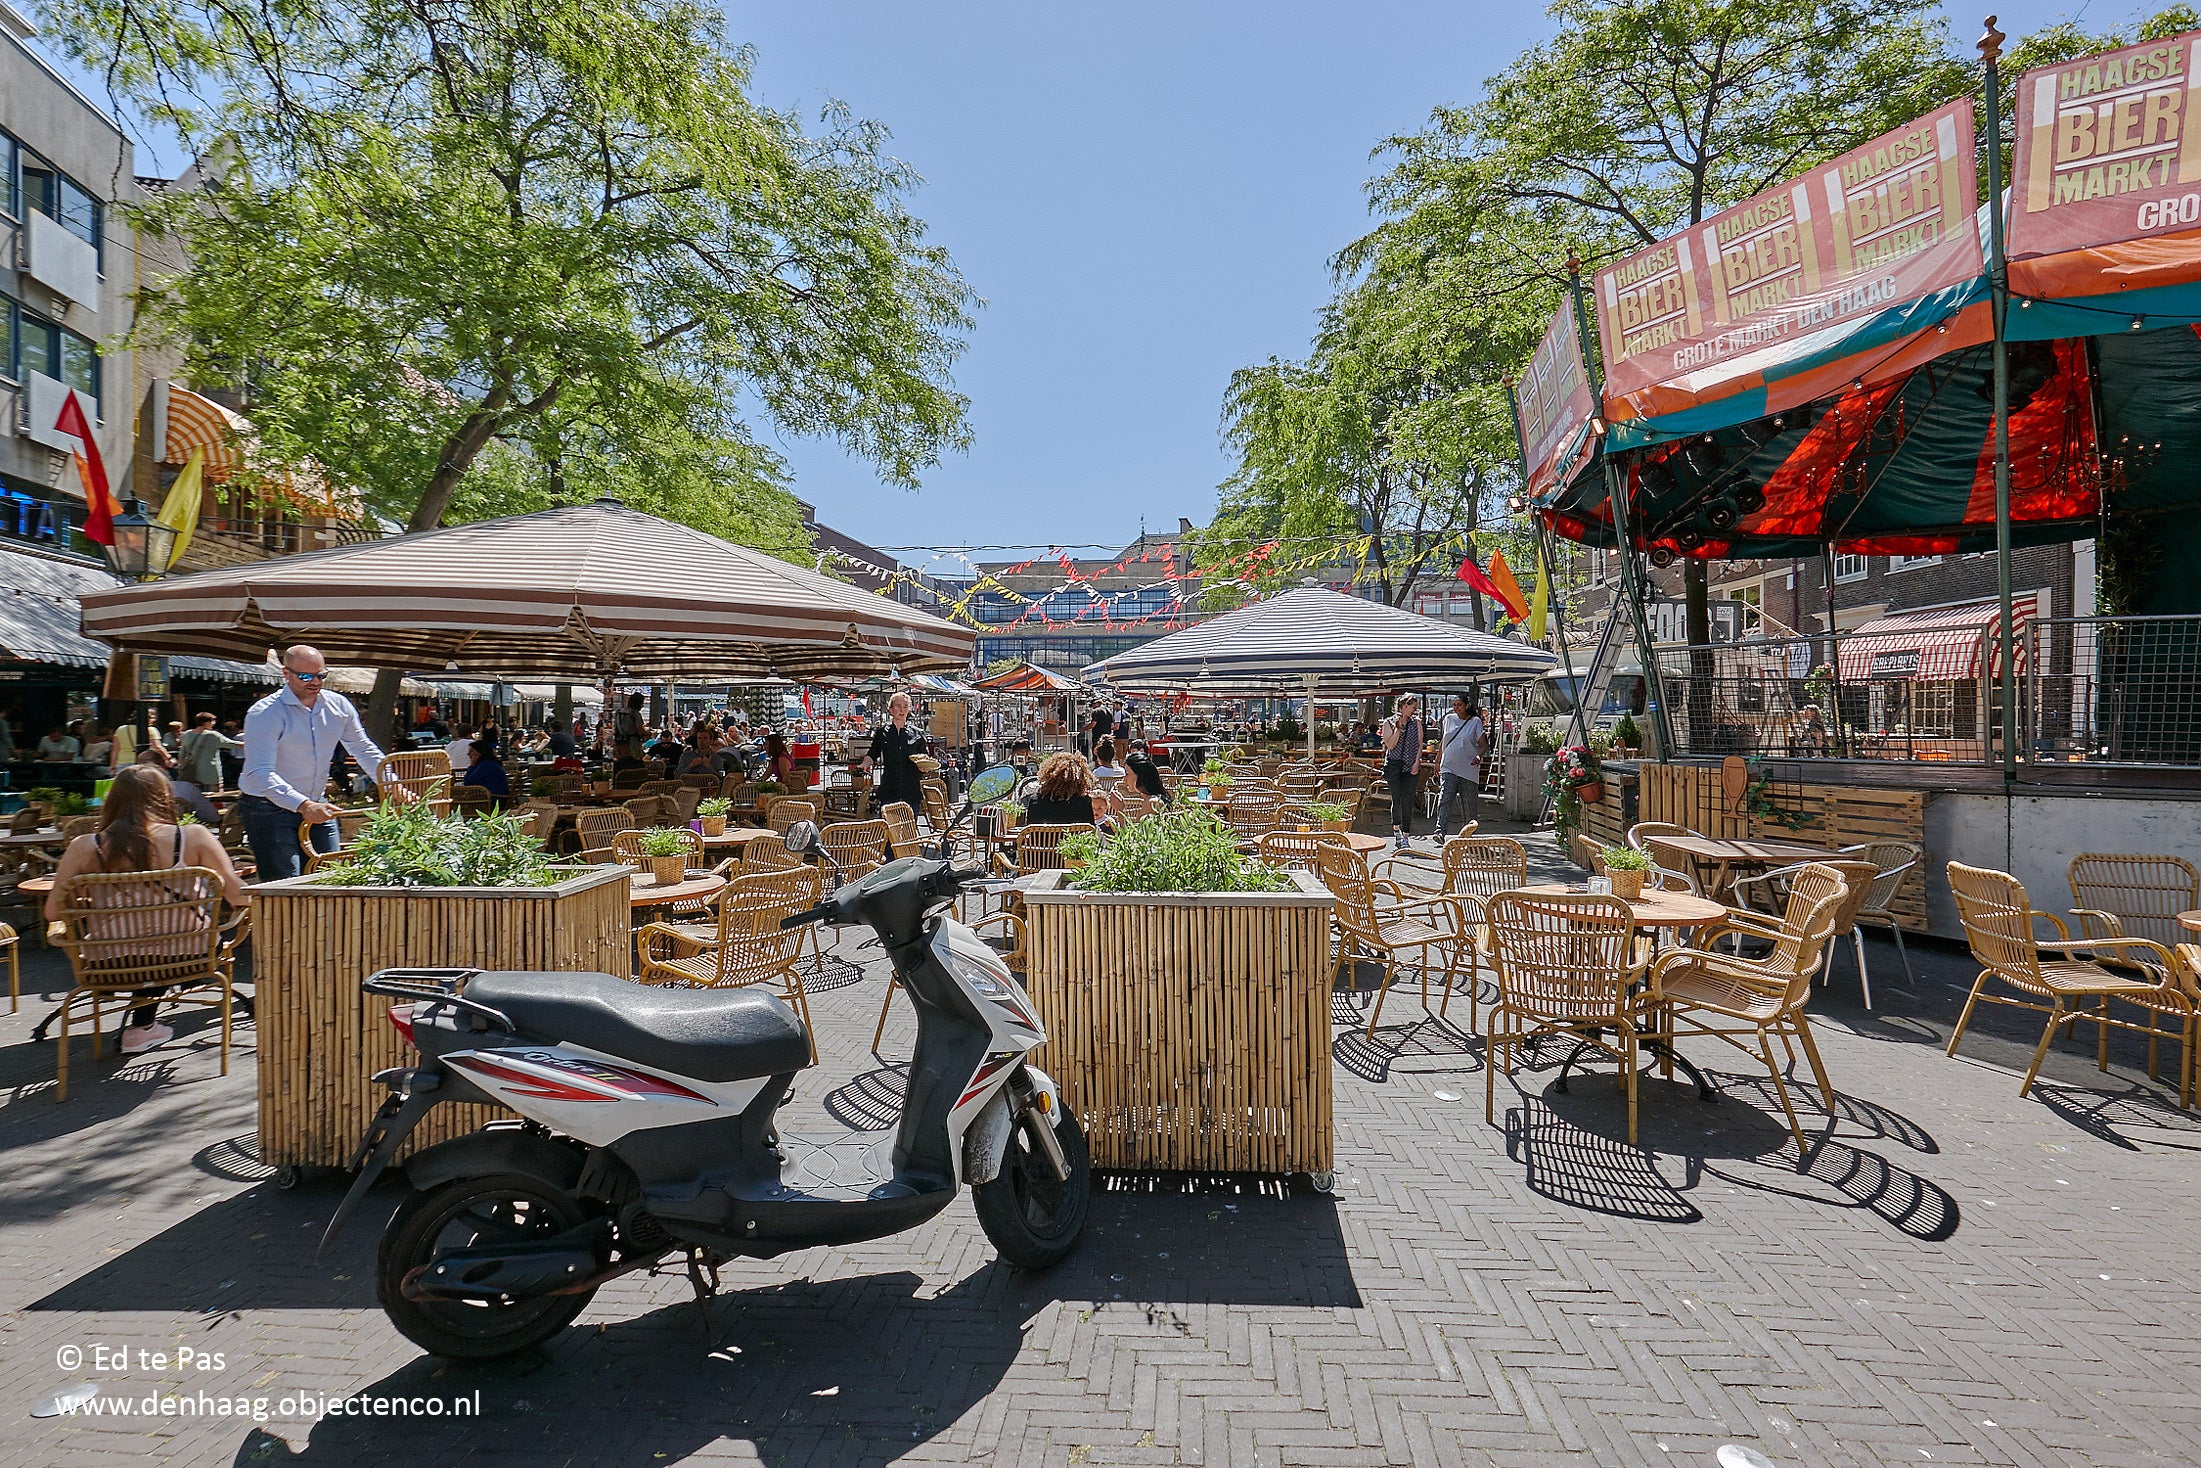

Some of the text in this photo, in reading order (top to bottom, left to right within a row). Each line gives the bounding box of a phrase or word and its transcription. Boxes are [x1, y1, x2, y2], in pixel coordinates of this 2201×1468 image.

[2060, 45, 2184, 101] HAAGSE
[2056, 88, 2183, 164] BIER
[1842, 126, 1934, 188] HAAGSE
[2053, 152, 2178, 207] MARKT
[1718, 193, 1791, 244] HAAGSE
[1847, 162, 1939, 240] BIER
[1616, 245, 1676, 288] HAAGSE
[1722, 224, 1799, 289] BIER
[1854, 217, 1942, 273] MARKT
[1619, 273, 1684, 330] BIER
[1673, 275, 1896, 370] GROTE MARKT DEN HAAG
[1730, 272, 1803, 320] MARKT
[1624, 315, 1689, 359] MARKT
